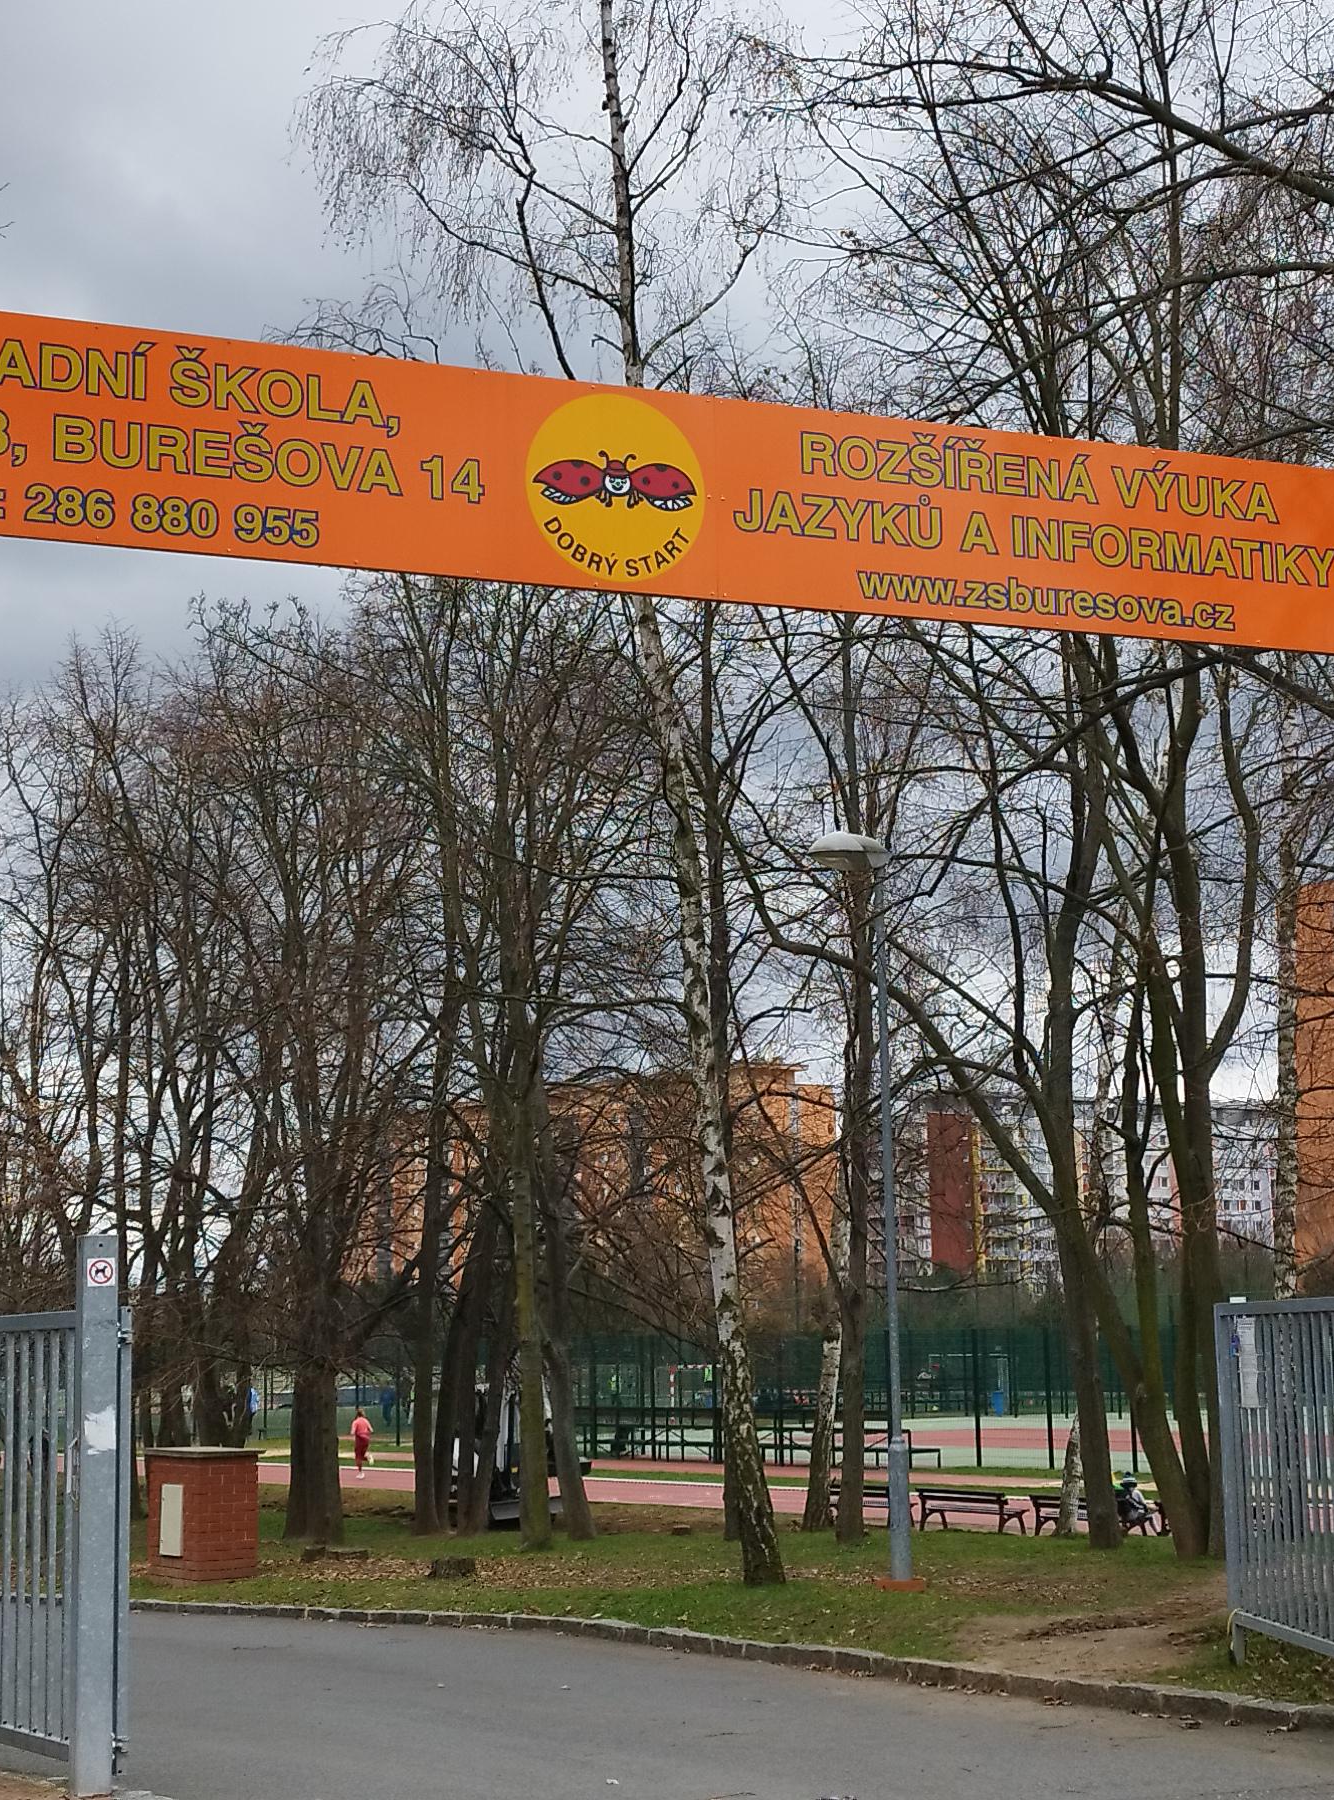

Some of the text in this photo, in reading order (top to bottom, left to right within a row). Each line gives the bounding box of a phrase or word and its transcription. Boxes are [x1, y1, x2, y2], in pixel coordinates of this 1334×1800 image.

[169, 345, 400, 438] ŠKOLA,
[53, 413, 403, 496] BUREŠOVA
[419, 454, 485, 504] 14
[800, 431, 1280, 524] ROZŠÍŘENÁ VÝUKA
[24, 483, 115, 529] 286
[129, 493, 219, 540] 880
[232, 504, 319, 548] 955
[544, 516, 691, 578] DOBRÝ START
[733, 488, 942, 549] JAZYKŮ
[960, 511, 999, 556] A
[856, 570, 1235, 631] www.zsburesova.cz
